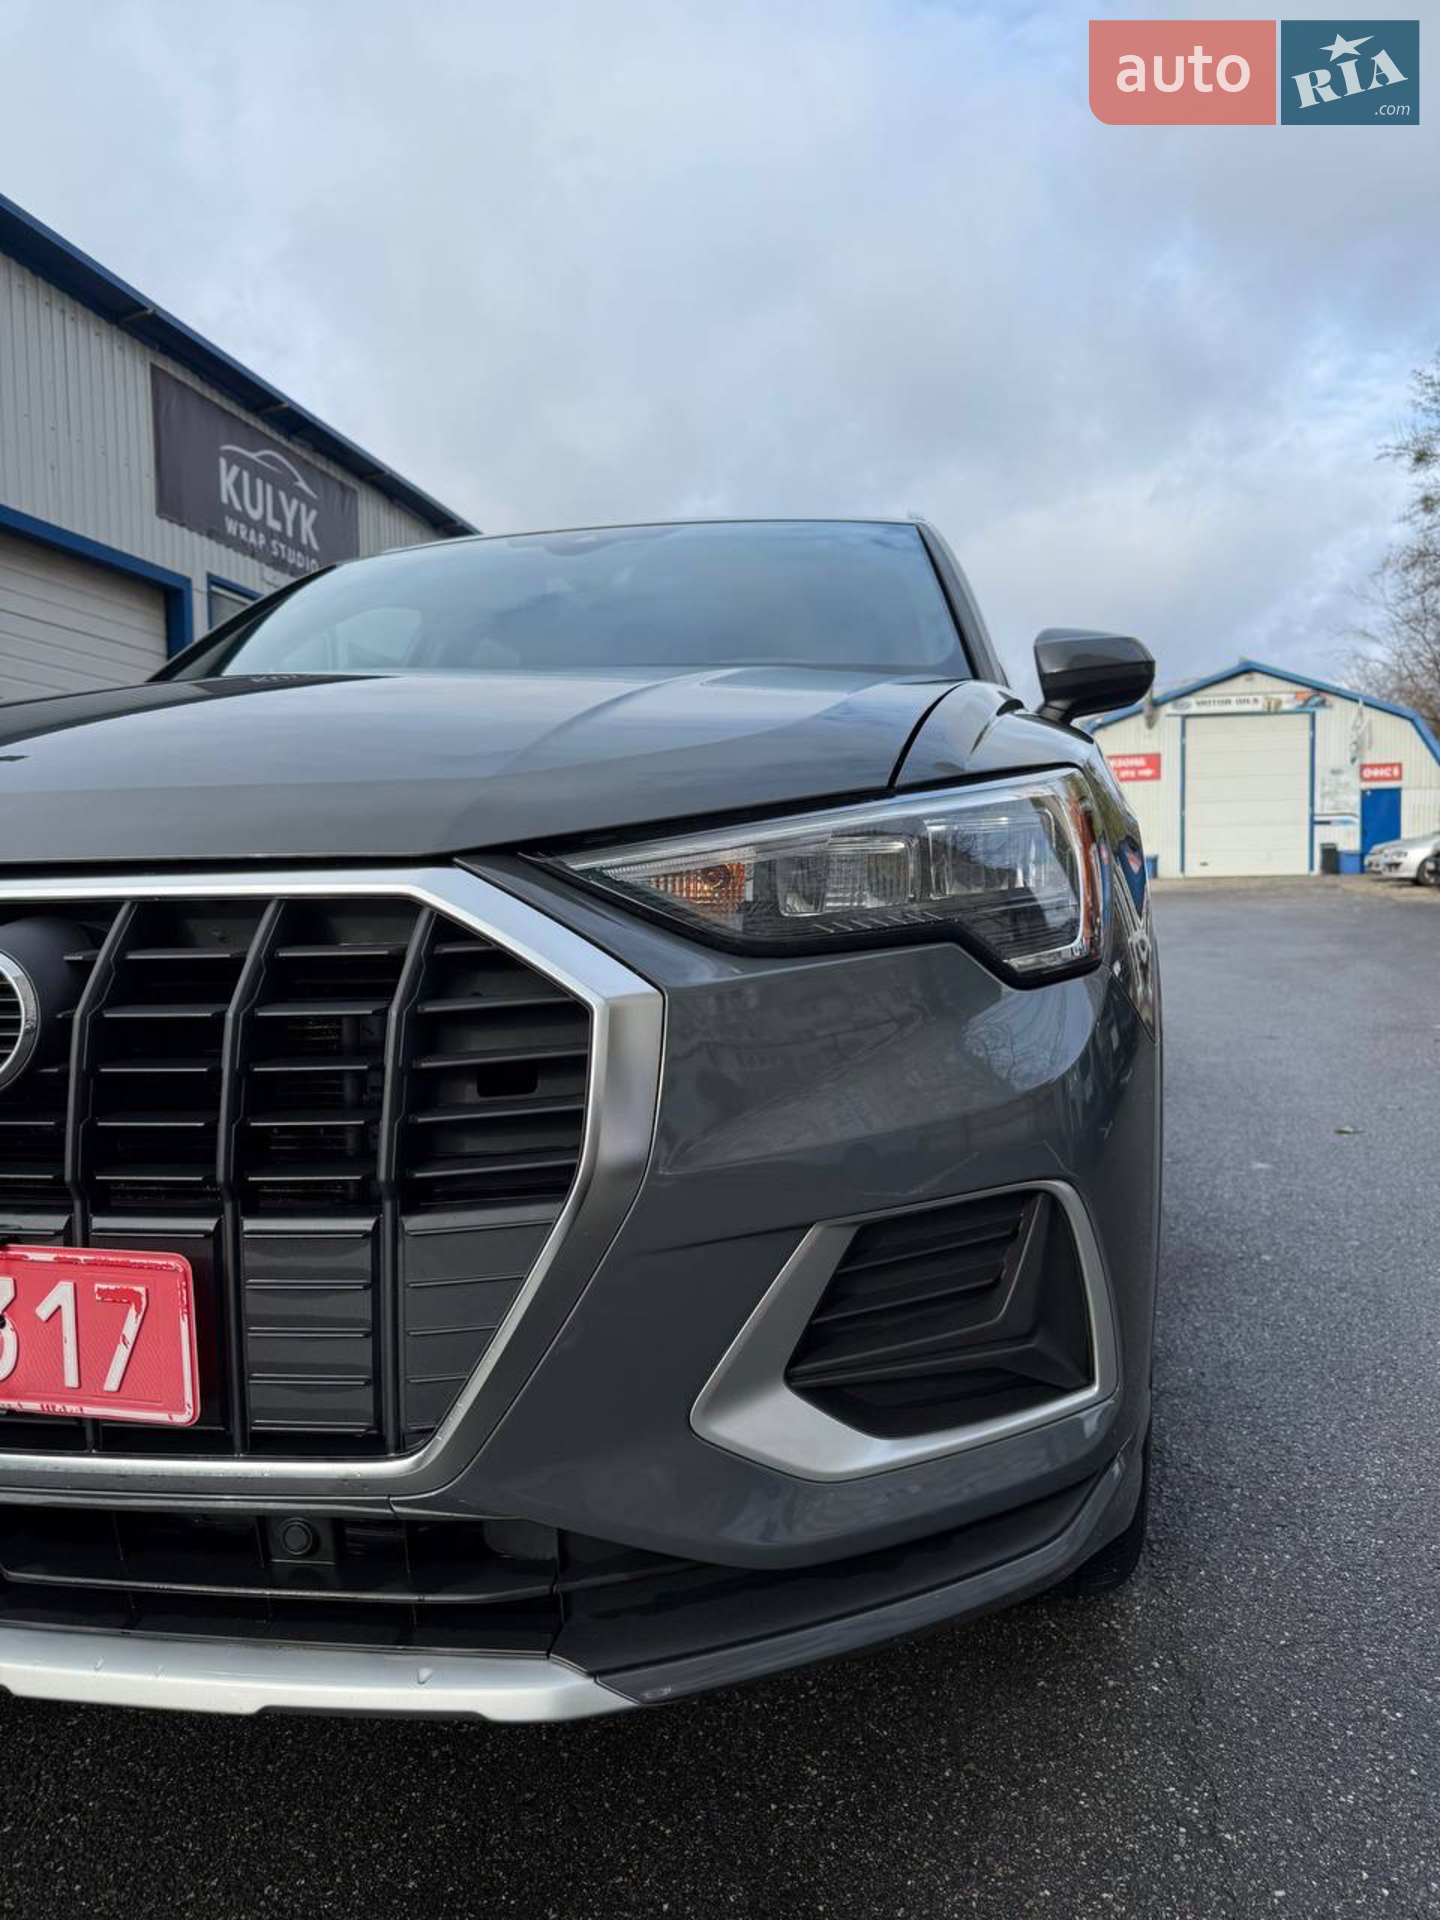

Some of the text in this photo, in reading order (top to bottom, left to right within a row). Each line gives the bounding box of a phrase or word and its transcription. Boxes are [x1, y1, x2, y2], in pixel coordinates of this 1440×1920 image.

[219, 456, 319, 551] KULYK
[225, 515, 319, 572] WRAP STUDIO
